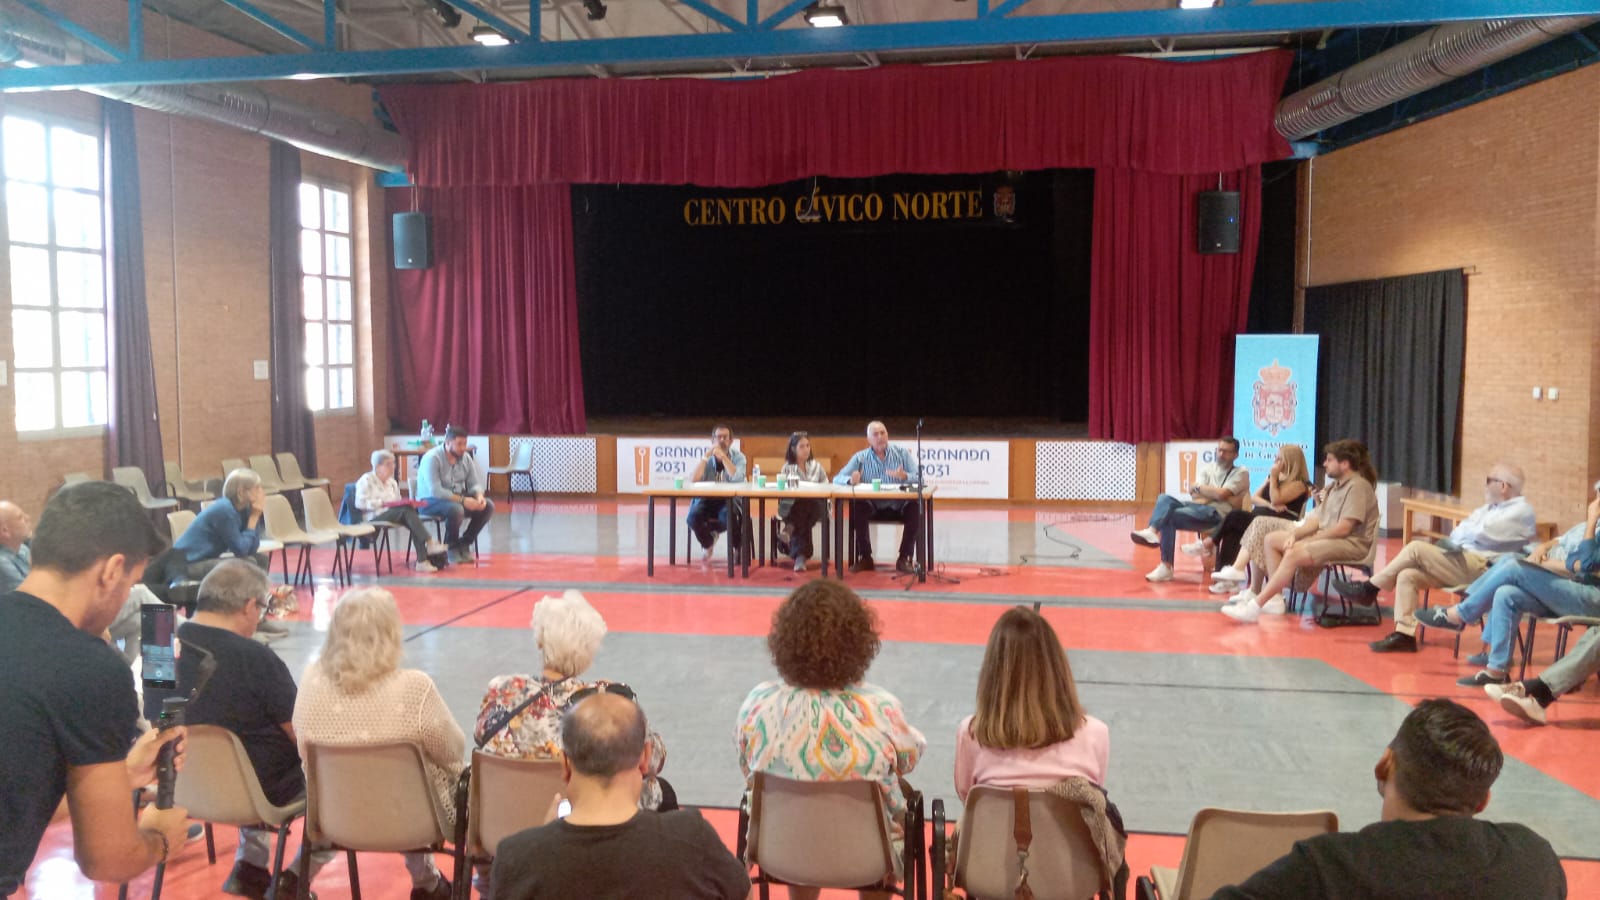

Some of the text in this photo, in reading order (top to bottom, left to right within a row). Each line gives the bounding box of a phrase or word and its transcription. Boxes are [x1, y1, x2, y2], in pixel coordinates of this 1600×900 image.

[683, 197, 786, 226] CENTRO
[893, 190, 983, 220] NORTE
[917, 448, 990, 461] GRANADA
[655, 461, 686, 474] 2031
